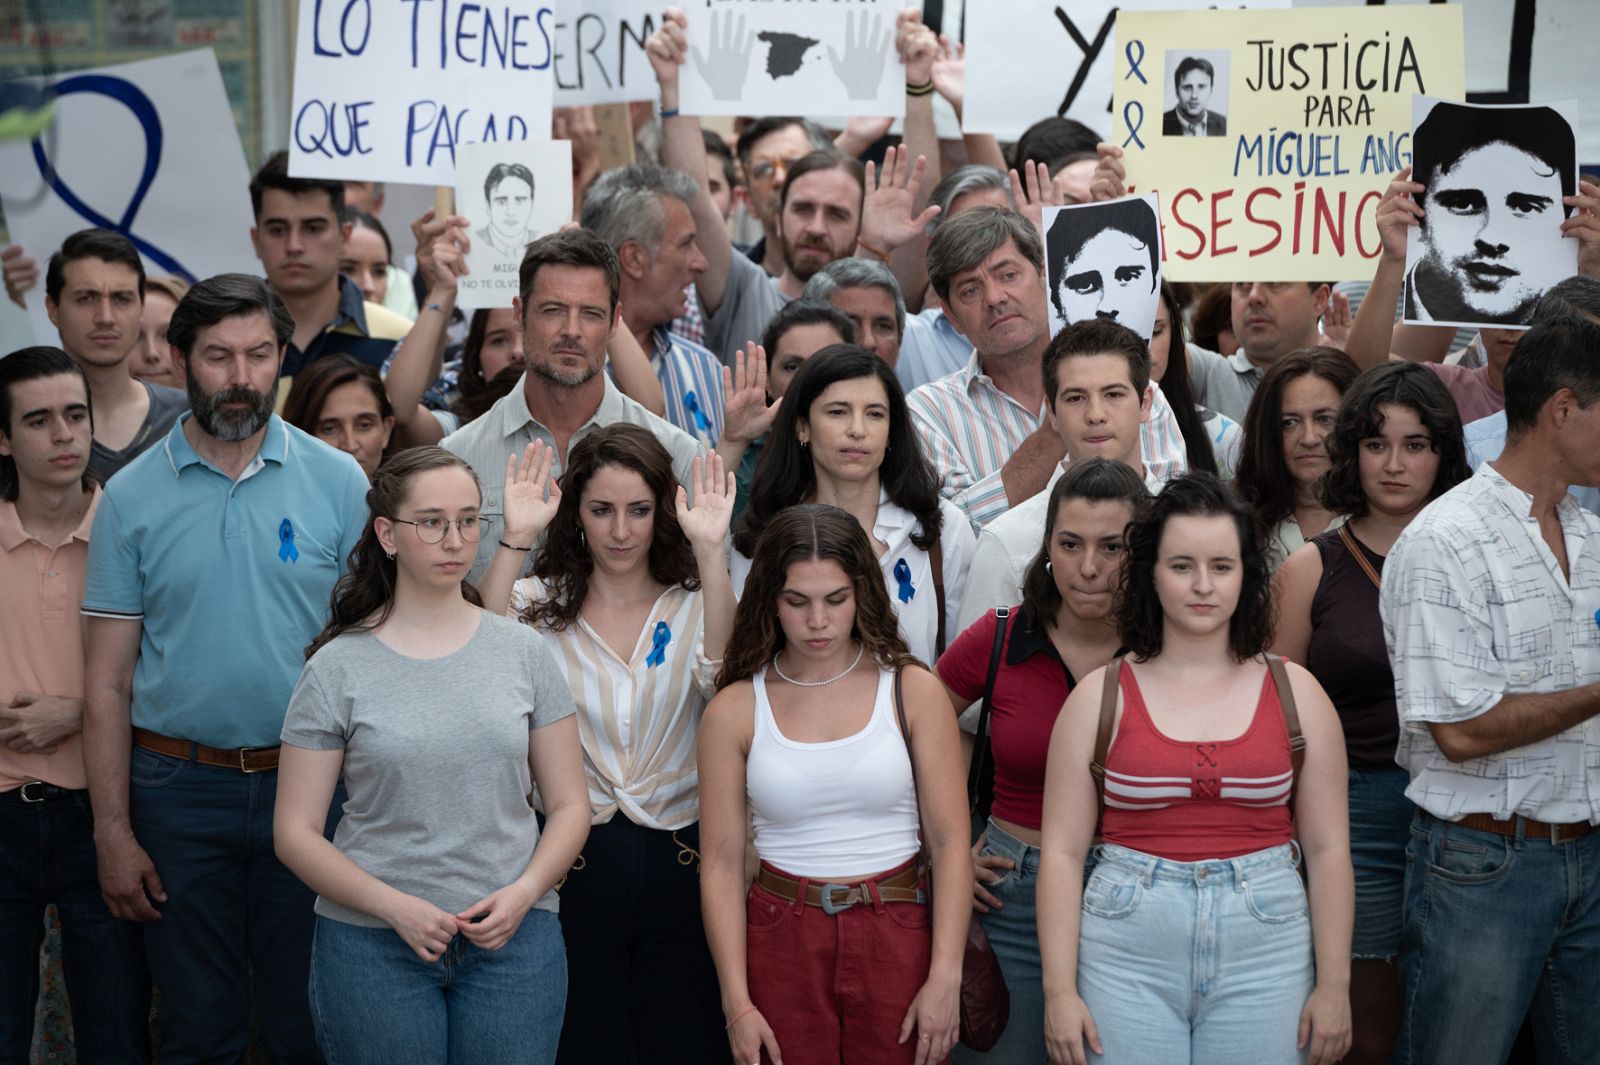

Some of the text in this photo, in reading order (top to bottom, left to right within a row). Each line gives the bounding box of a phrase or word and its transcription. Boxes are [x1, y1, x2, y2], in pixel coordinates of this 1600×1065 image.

[313, 0, 552, 70] LO TIENES
[553, 12, 667, 90] ERM
[1246, 30, 1426, 95] JUSTICIA
[295, 99, 375, 158] QUE
[1303, 93, 1376, 127] PARA
[462, 279, 478, 289] NO
[481, 279, 492, 289] TE
